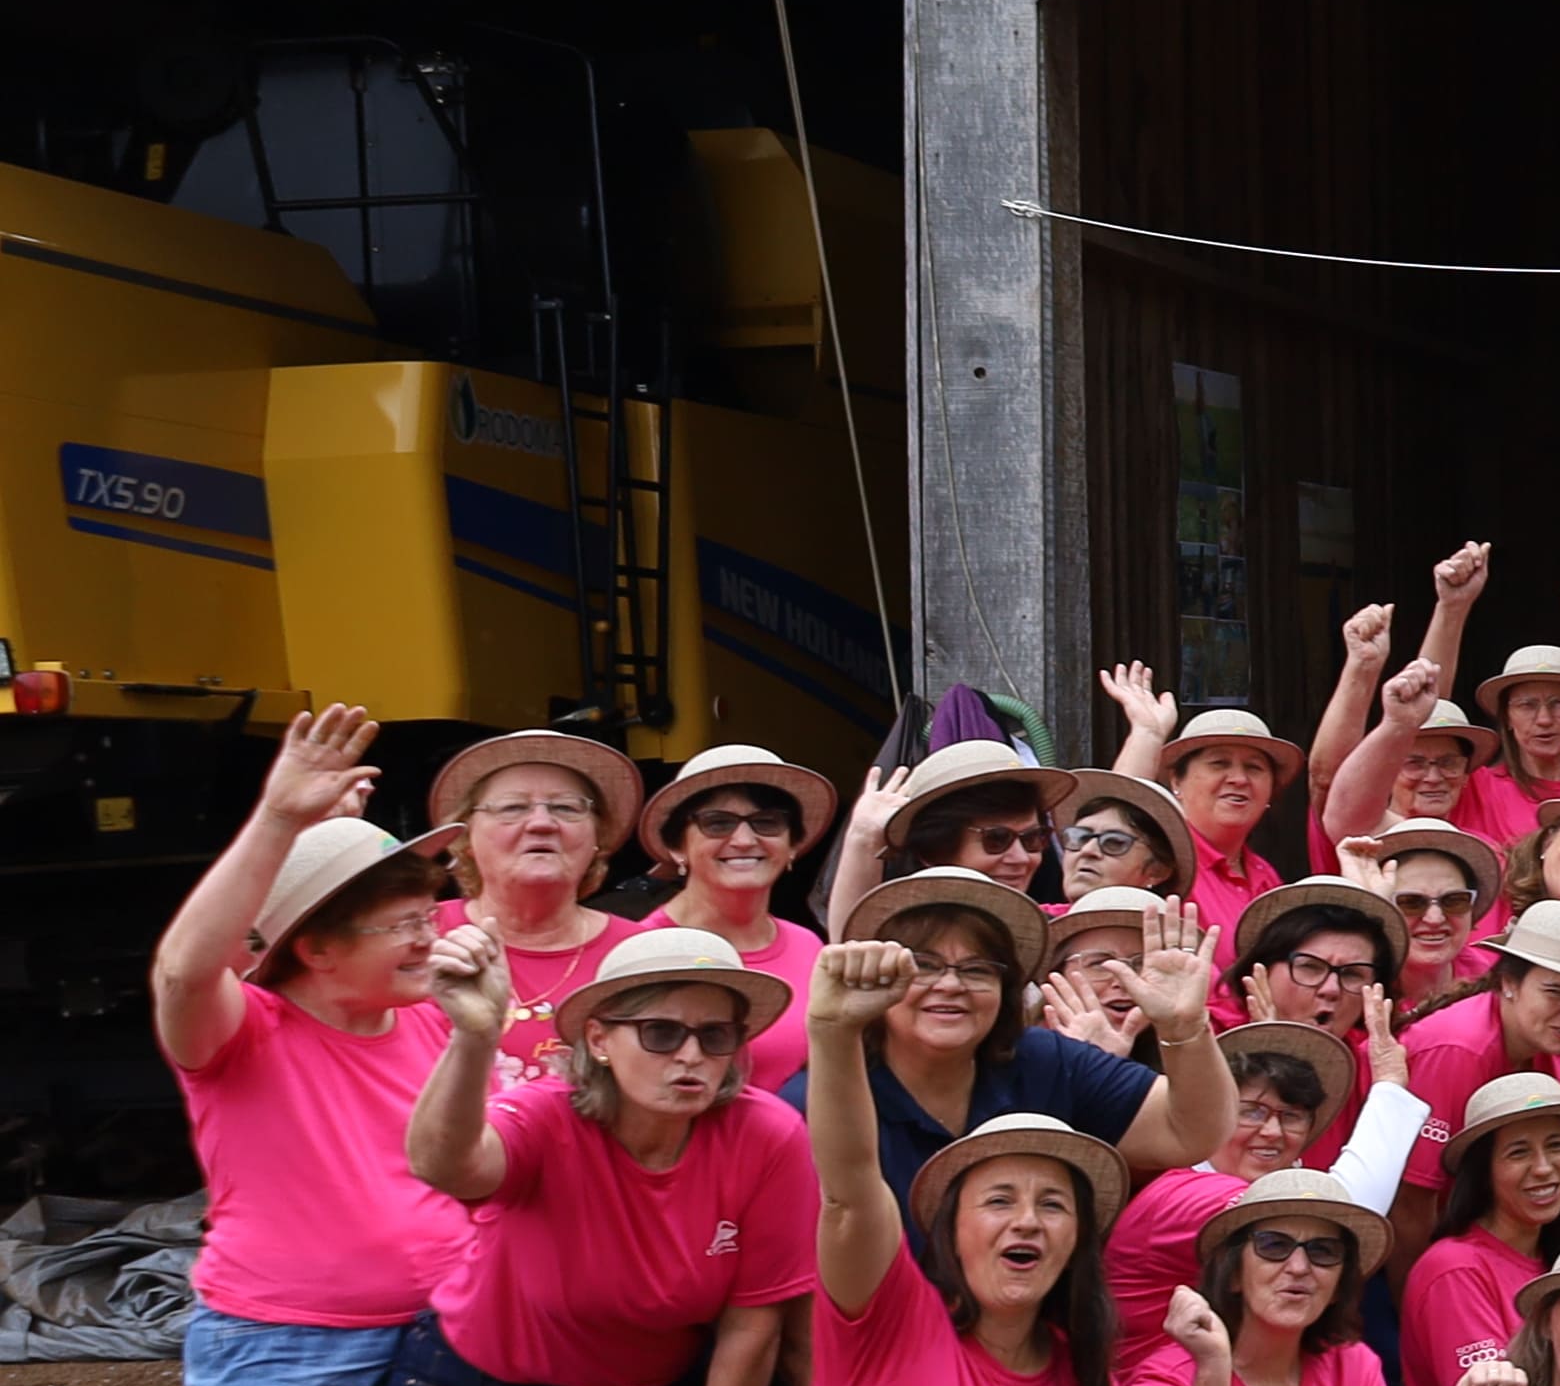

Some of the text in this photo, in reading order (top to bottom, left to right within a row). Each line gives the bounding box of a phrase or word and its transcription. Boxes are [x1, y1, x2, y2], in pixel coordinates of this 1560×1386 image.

[76, 468, 185, 519] TX5.90
[719, 565, 780, 633] NEW
[1456, 1339, 1496, 1356] somos
